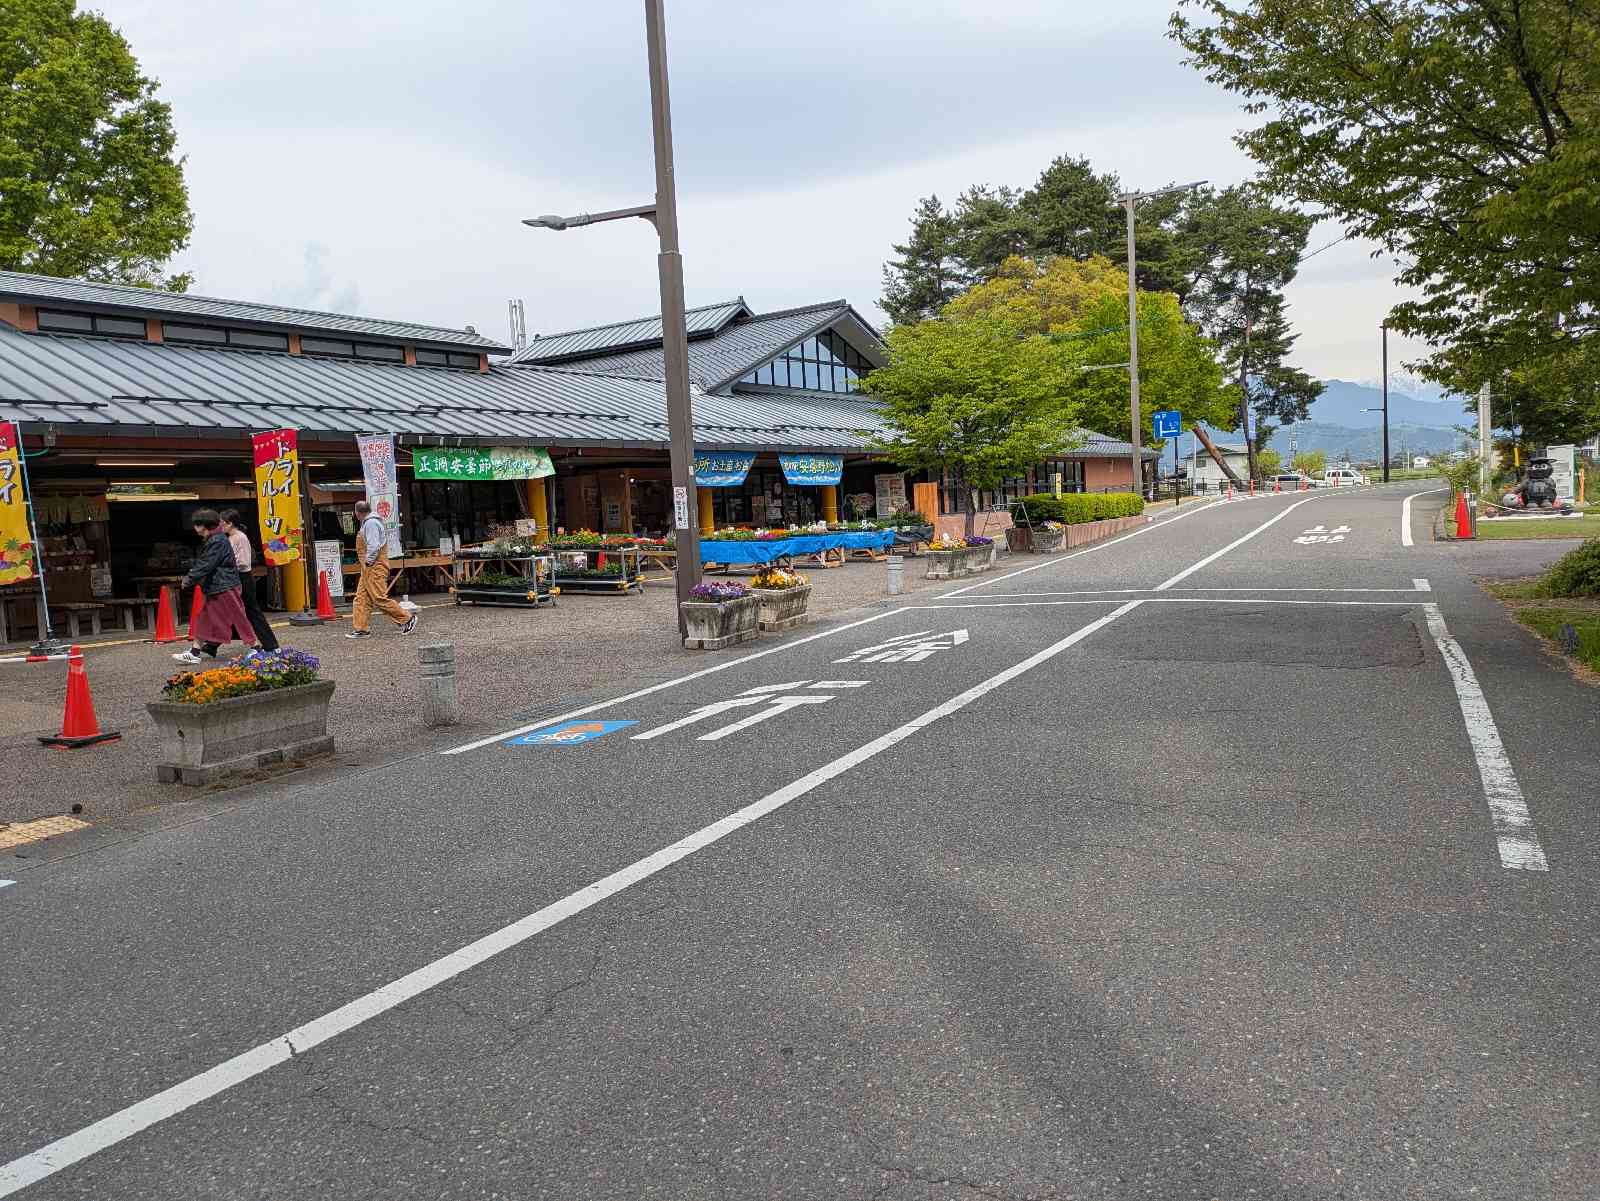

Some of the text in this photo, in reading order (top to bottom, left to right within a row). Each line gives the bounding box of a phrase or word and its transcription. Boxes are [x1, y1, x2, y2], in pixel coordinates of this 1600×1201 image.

[261, 459, 283, 535] フルーツ
[276, 440, 295, 497] ドライ
[629, 628, 970, 741] 徐行
